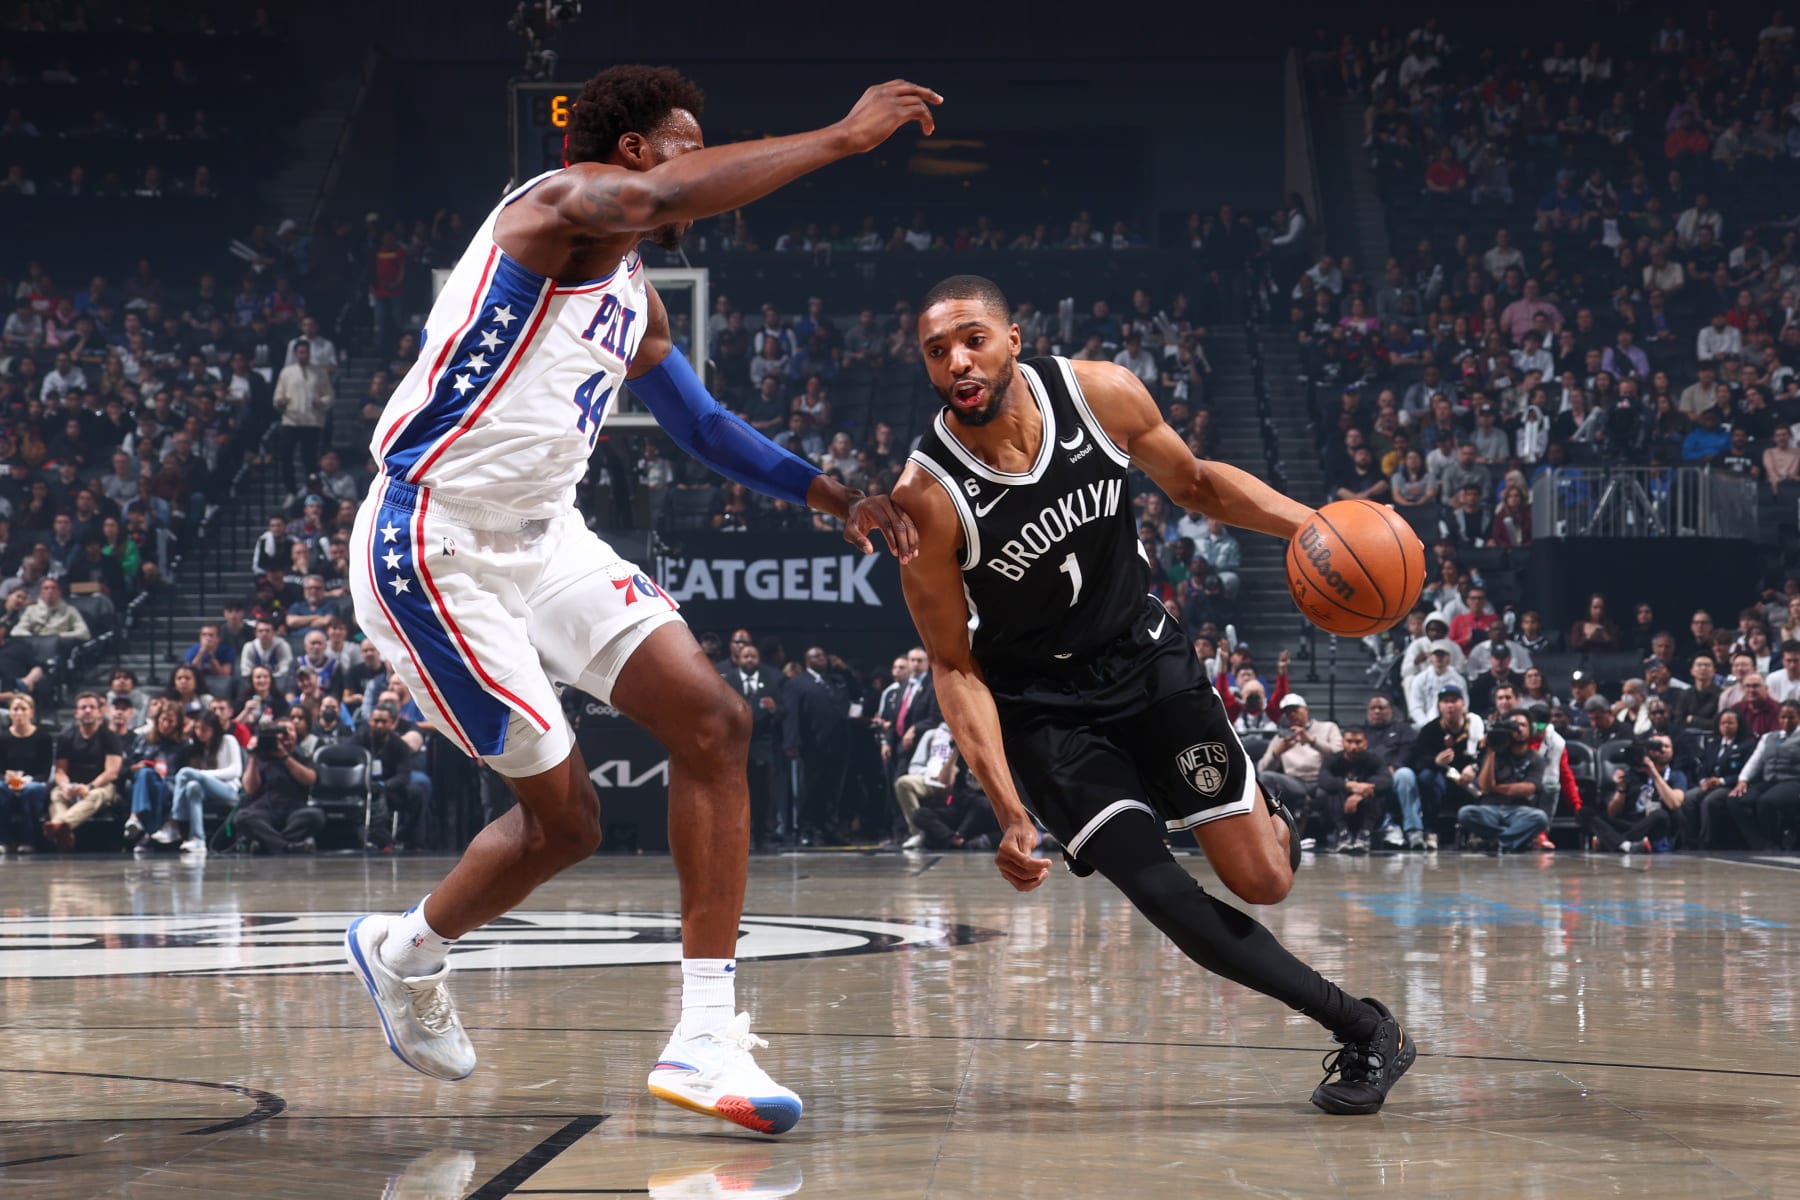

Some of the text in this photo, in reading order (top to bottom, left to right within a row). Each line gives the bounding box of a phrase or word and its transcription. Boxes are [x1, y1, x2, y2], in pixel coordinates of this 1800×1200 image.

[551, 95, 569, 128] 6
[573, 370, 613, 450] 44
[963, 477, 981, 497] 6
[986, 479, 1122, 582] BROOKLYN
[1299, 522, 1357, 602] Wilson
[611, 574, 659, 607] 76
[656, 551, 883, 607] EATGEEK
[1059, 552, 1083, 608] 1
[585, 703, 621, 718] Goog
[1179, 744, 1227, 775] NETS
[1202, 769, 1215, 790] B
